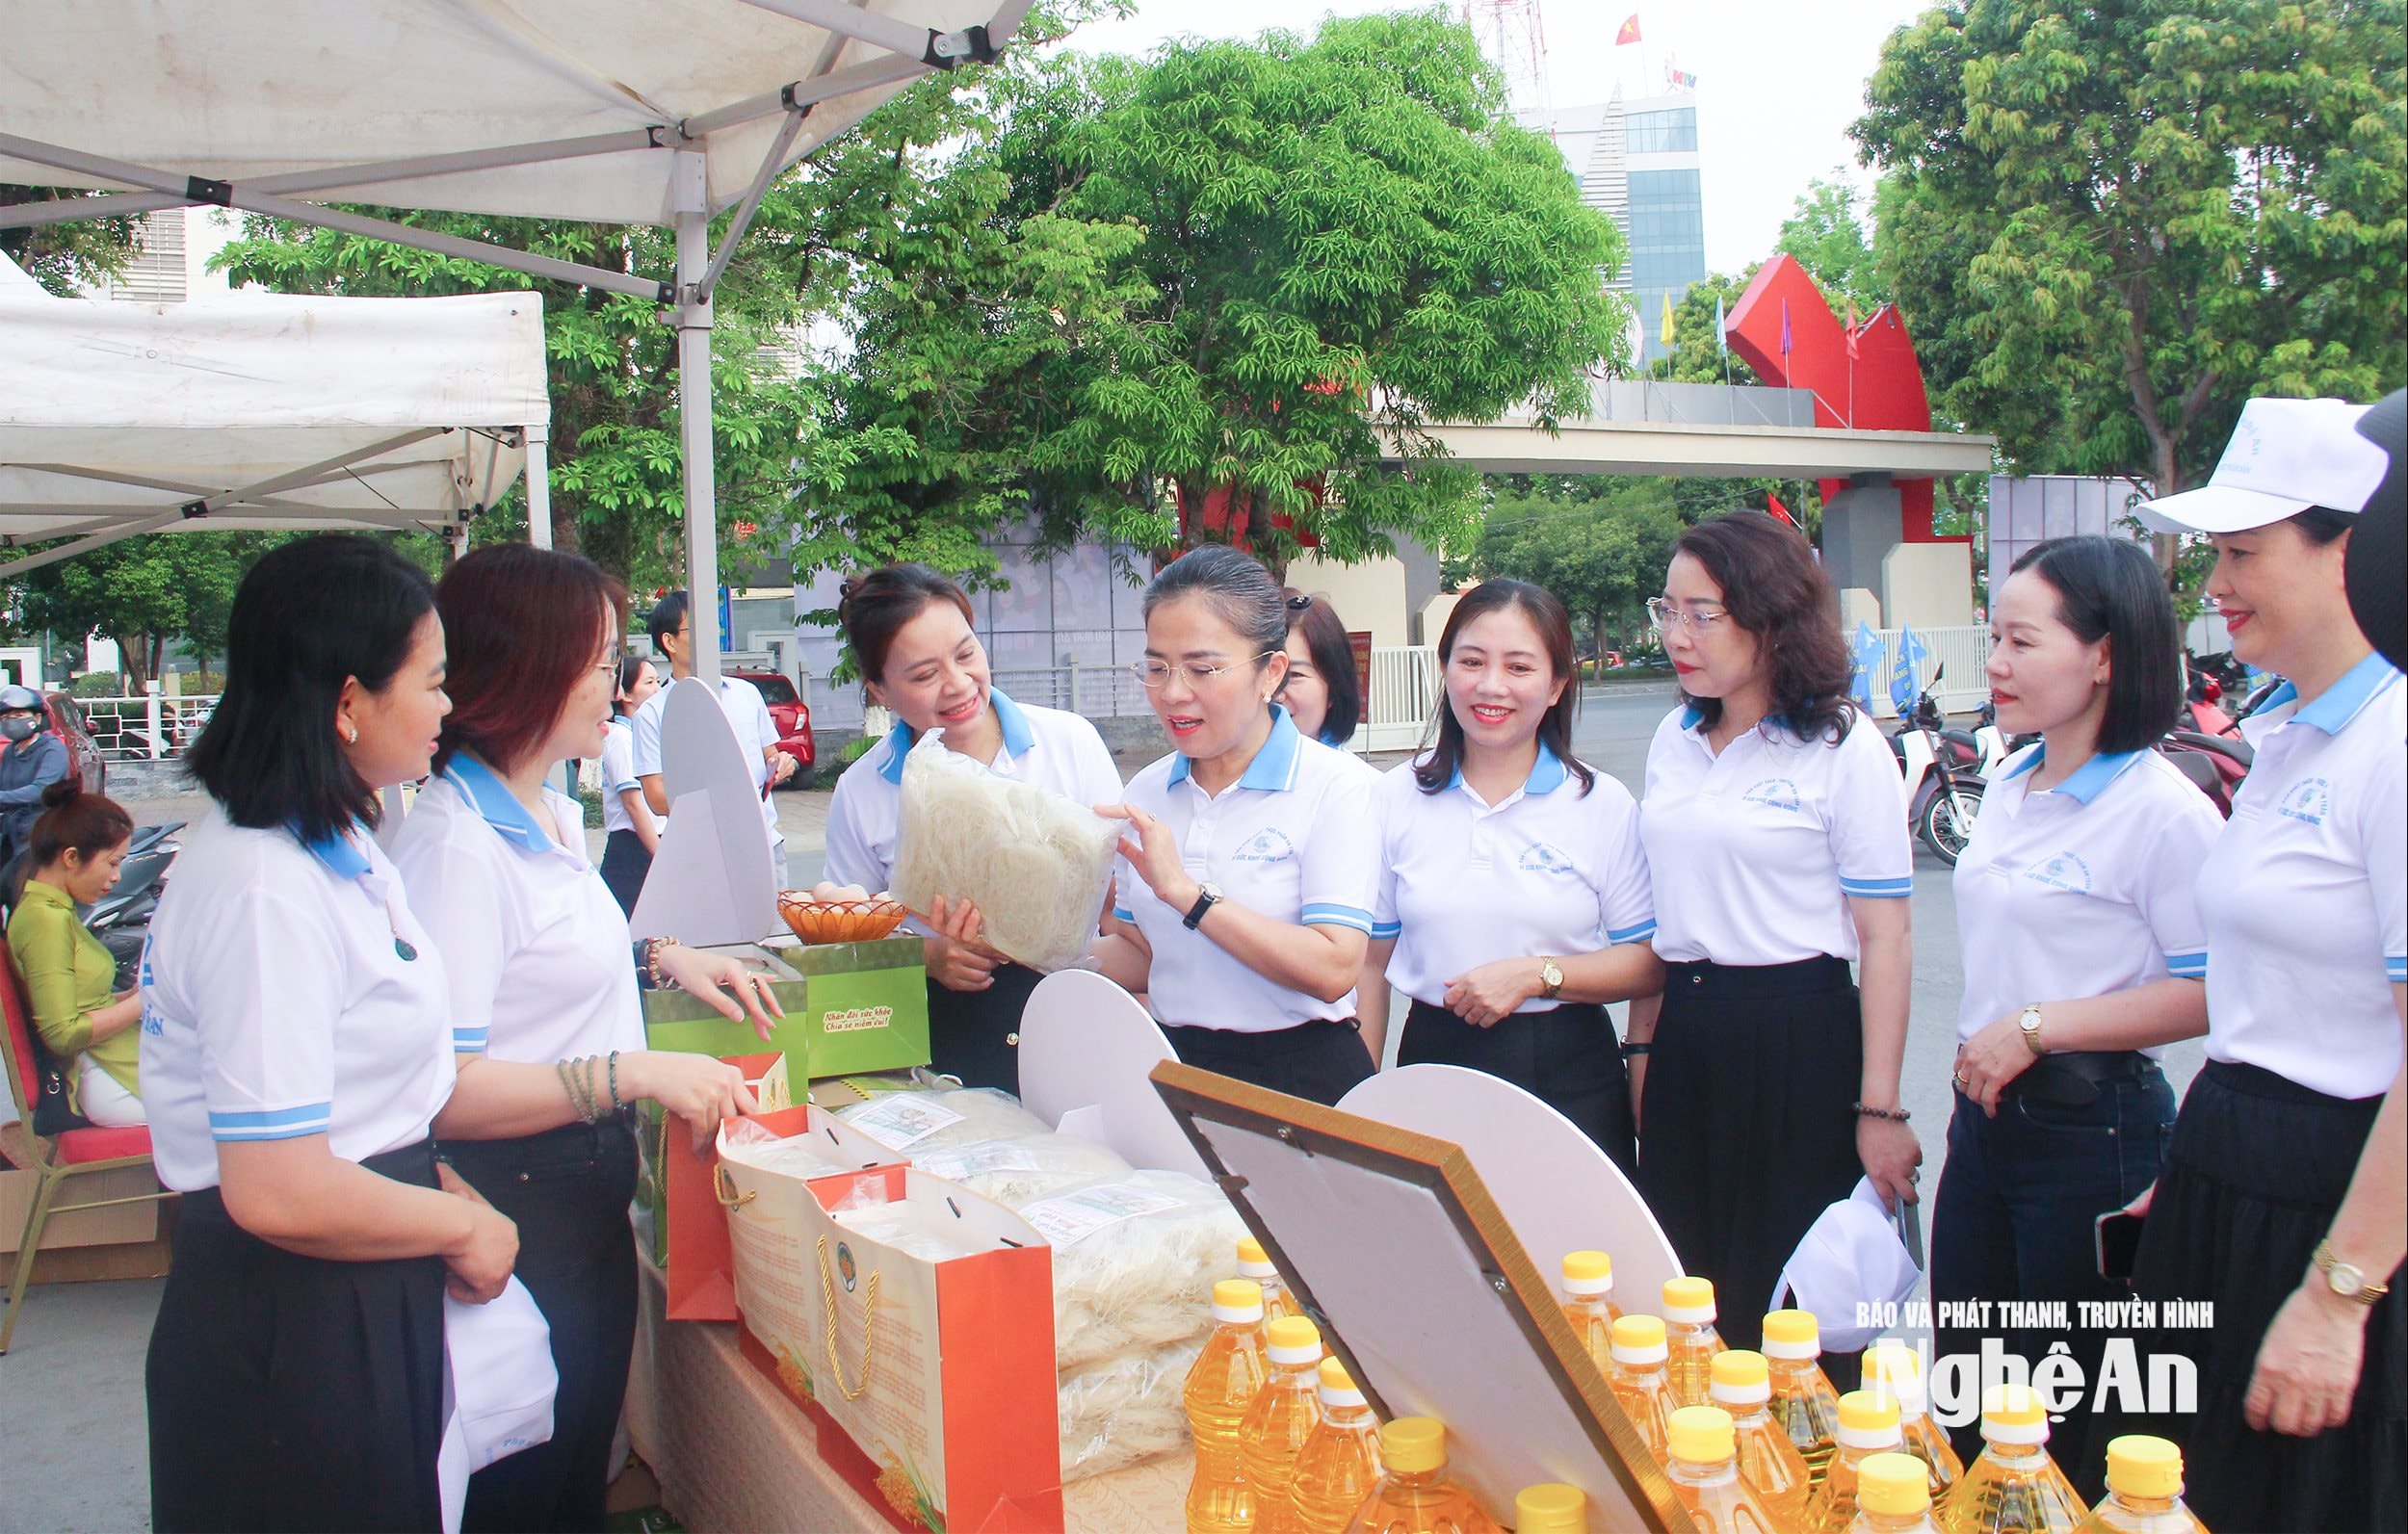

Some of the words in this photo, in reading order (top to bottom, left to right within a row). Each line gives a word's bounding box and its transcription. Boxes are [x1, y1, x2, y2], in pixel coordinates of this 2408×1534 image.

[825, 1012, 845, 1022] Nhân
[848, 1010, 858, 1019] đôi
[860, 1008, 873, 1018] sức
[825, 1021, 843, 1031] Chia
[874, 1017, 889, 1027] vui!
